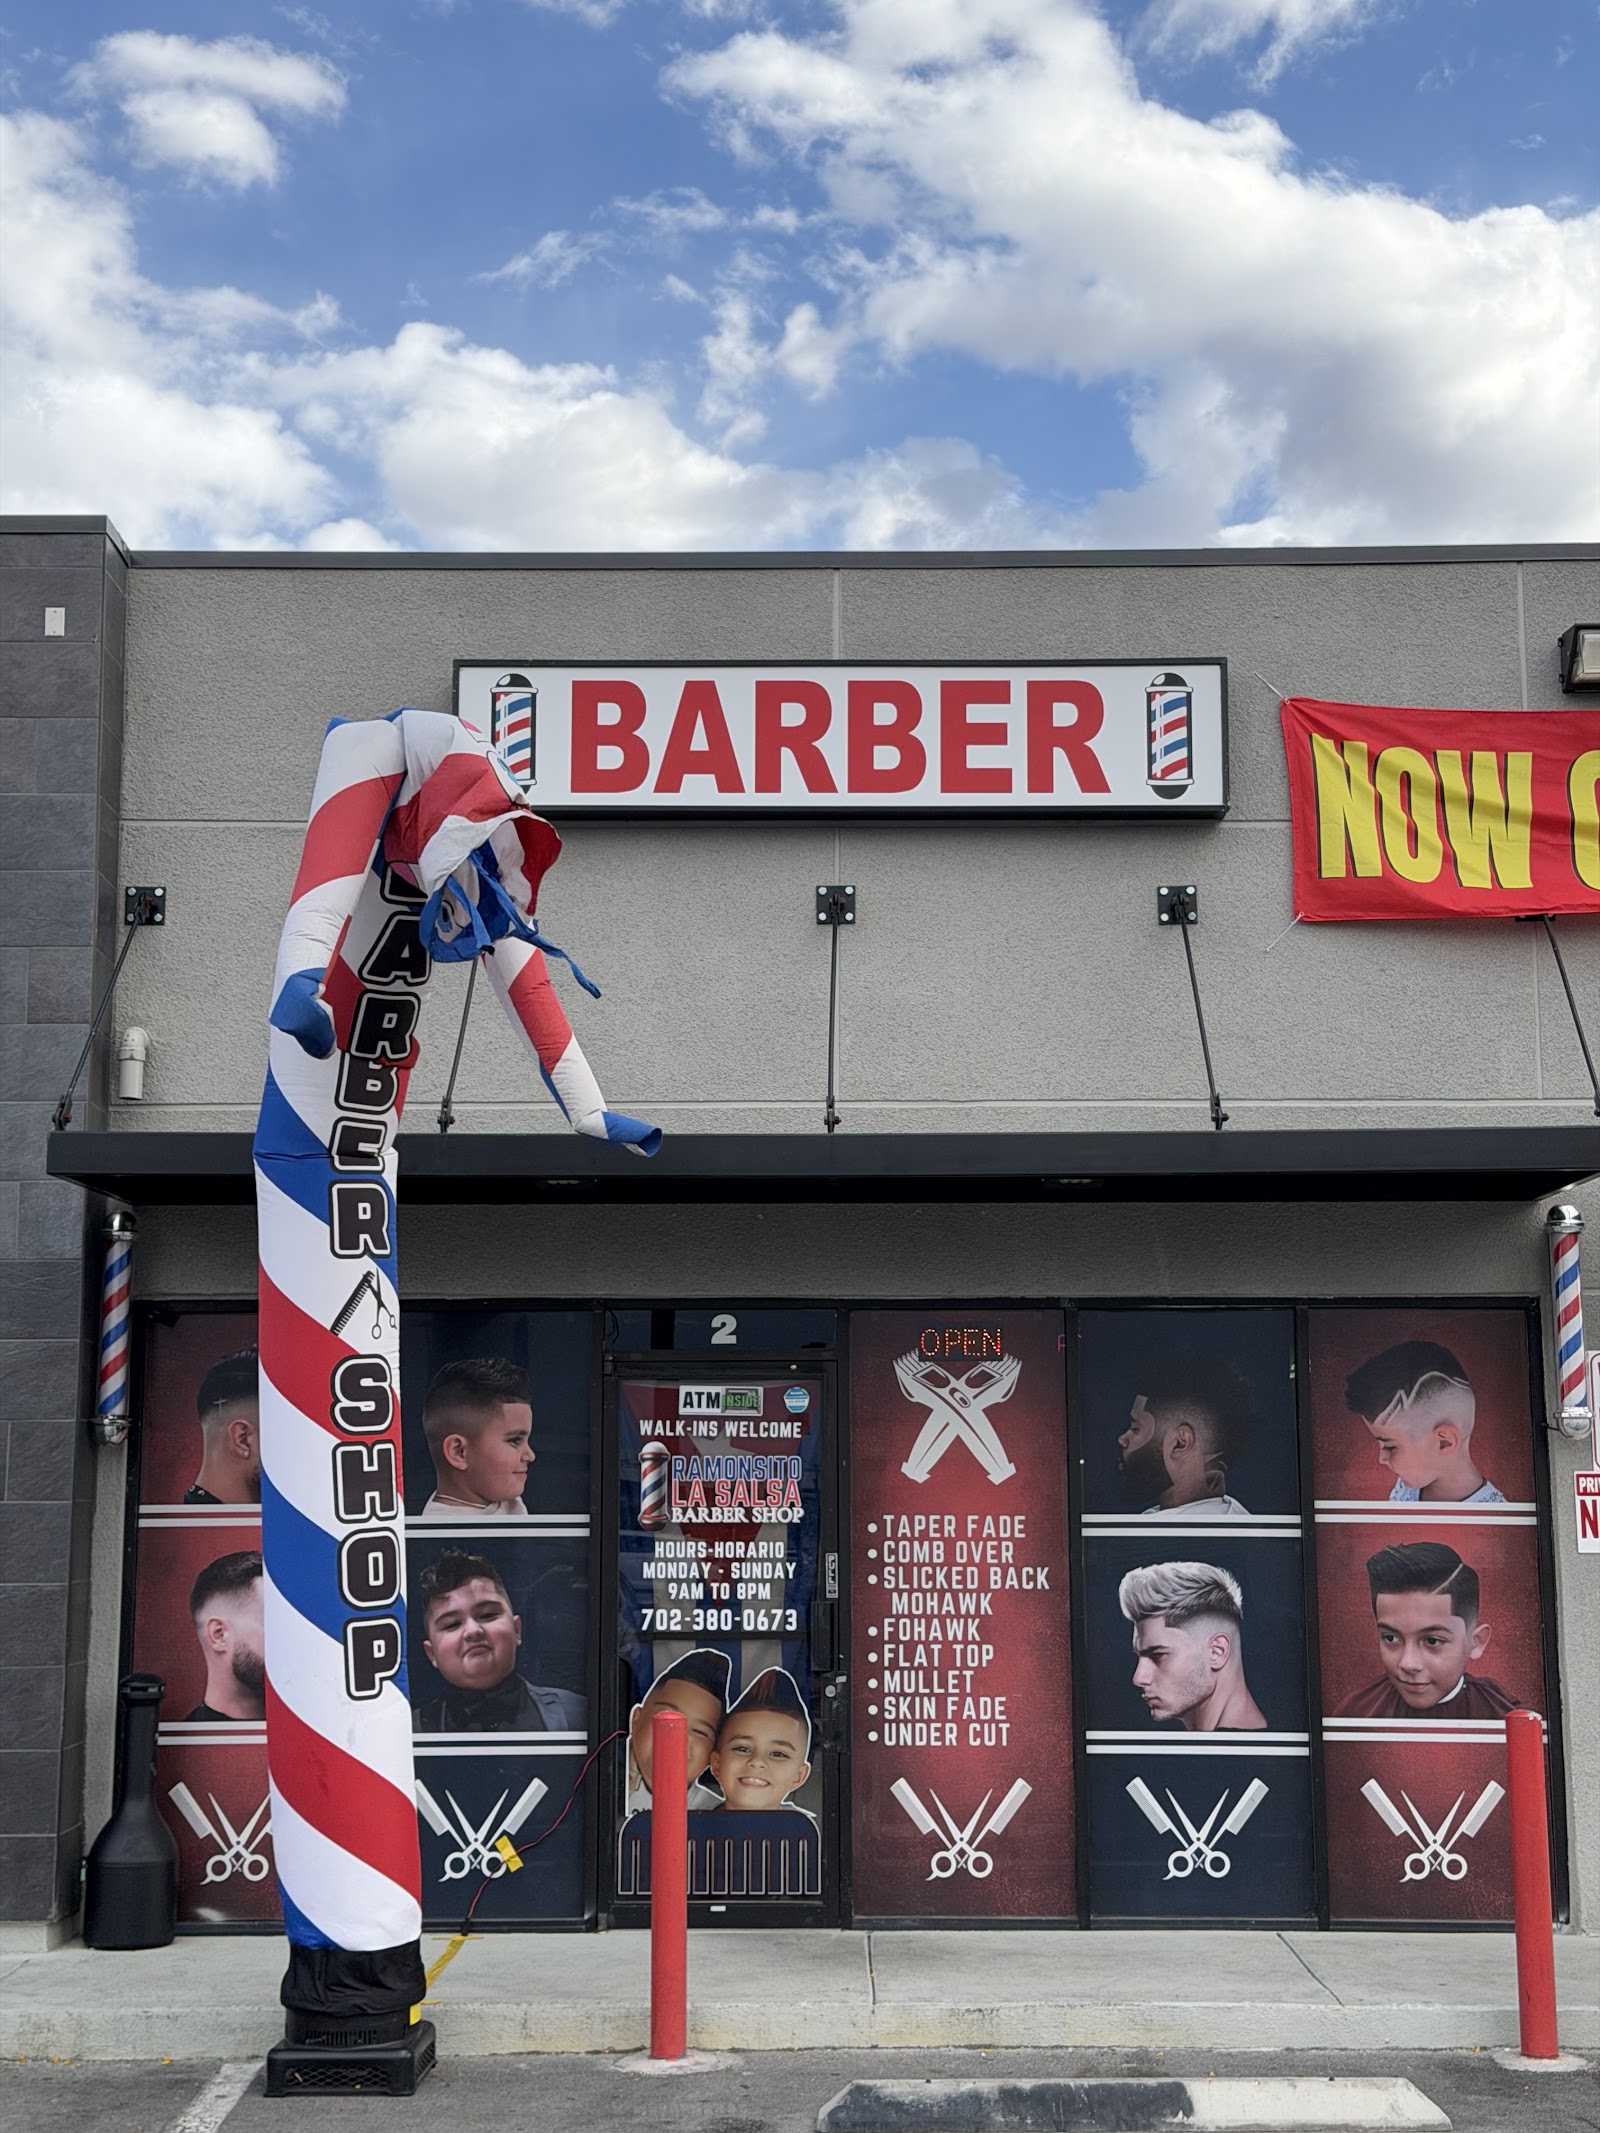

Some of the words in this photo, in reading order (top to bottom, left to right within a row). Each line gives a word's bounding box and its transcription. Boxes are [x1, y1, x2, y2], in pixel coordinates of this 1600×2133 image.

[570, 680, 1112, 794] BARBER
[1309, 733, 1534, 889] NOW
[711, 1314, 737, 1344] 2
[920, 1328, 1002, 1357] OPEN
[682, 1392, 720, 1409] ATM
[639, 1420, 719, 1437] WALK-INS
[725, 1421, 802, 1438] WELCOME
[672, 1456, 802, 1481] RAMONSITO
[671, 1480, 706, 1507] LA
[715, 1480, 802, 1507] SALSA
[1579, 1477, 1600, 1493] PRI
[671, 1507, 749, 1523] BARBER
[752, 1507, 804, 1524] SHOP
[883, 1515, 956, 1538] TAPER
[967, 1515, 1026, 1538] FADE
[330, 1353, 402, 1701] SHOP
[654, 1542, 785, 1558] HOURS-HORARIO
[883, 1541, 945, 1563] COMB
[955, 1541, 1014, 1563] OVER
[643, 1562, 711, 1579] MONDAY
[731, 1562, 796, 1579] SUNDAY
[884, 1567, 979, 1590] SLICKED
[990, 1567, 1049, 1590] BACK
[668, 1583, 704, 1600] 9AM
[711, 1583, 730, 1600] TO
[736, 1583, 771, 1600] 8PM
[892, 1593, 993, 1615] MOHAWK
[641, 1609, 797, 1631] 702-380-0673
[883, 1619, 981, 1641] FOHAWK
[884, 1645, 942, 1667] FLAT
[953, 1645, 994, 1667] TOP
[884, 1671, 974, 1694] MULLET
[884, 1697, 936, 1720] SKIN
[947, 1697, 1007, 1720] FADE
[884, 1724, 958, 1746] UNDER
[968, 1724, 1010, 1746] CUT
